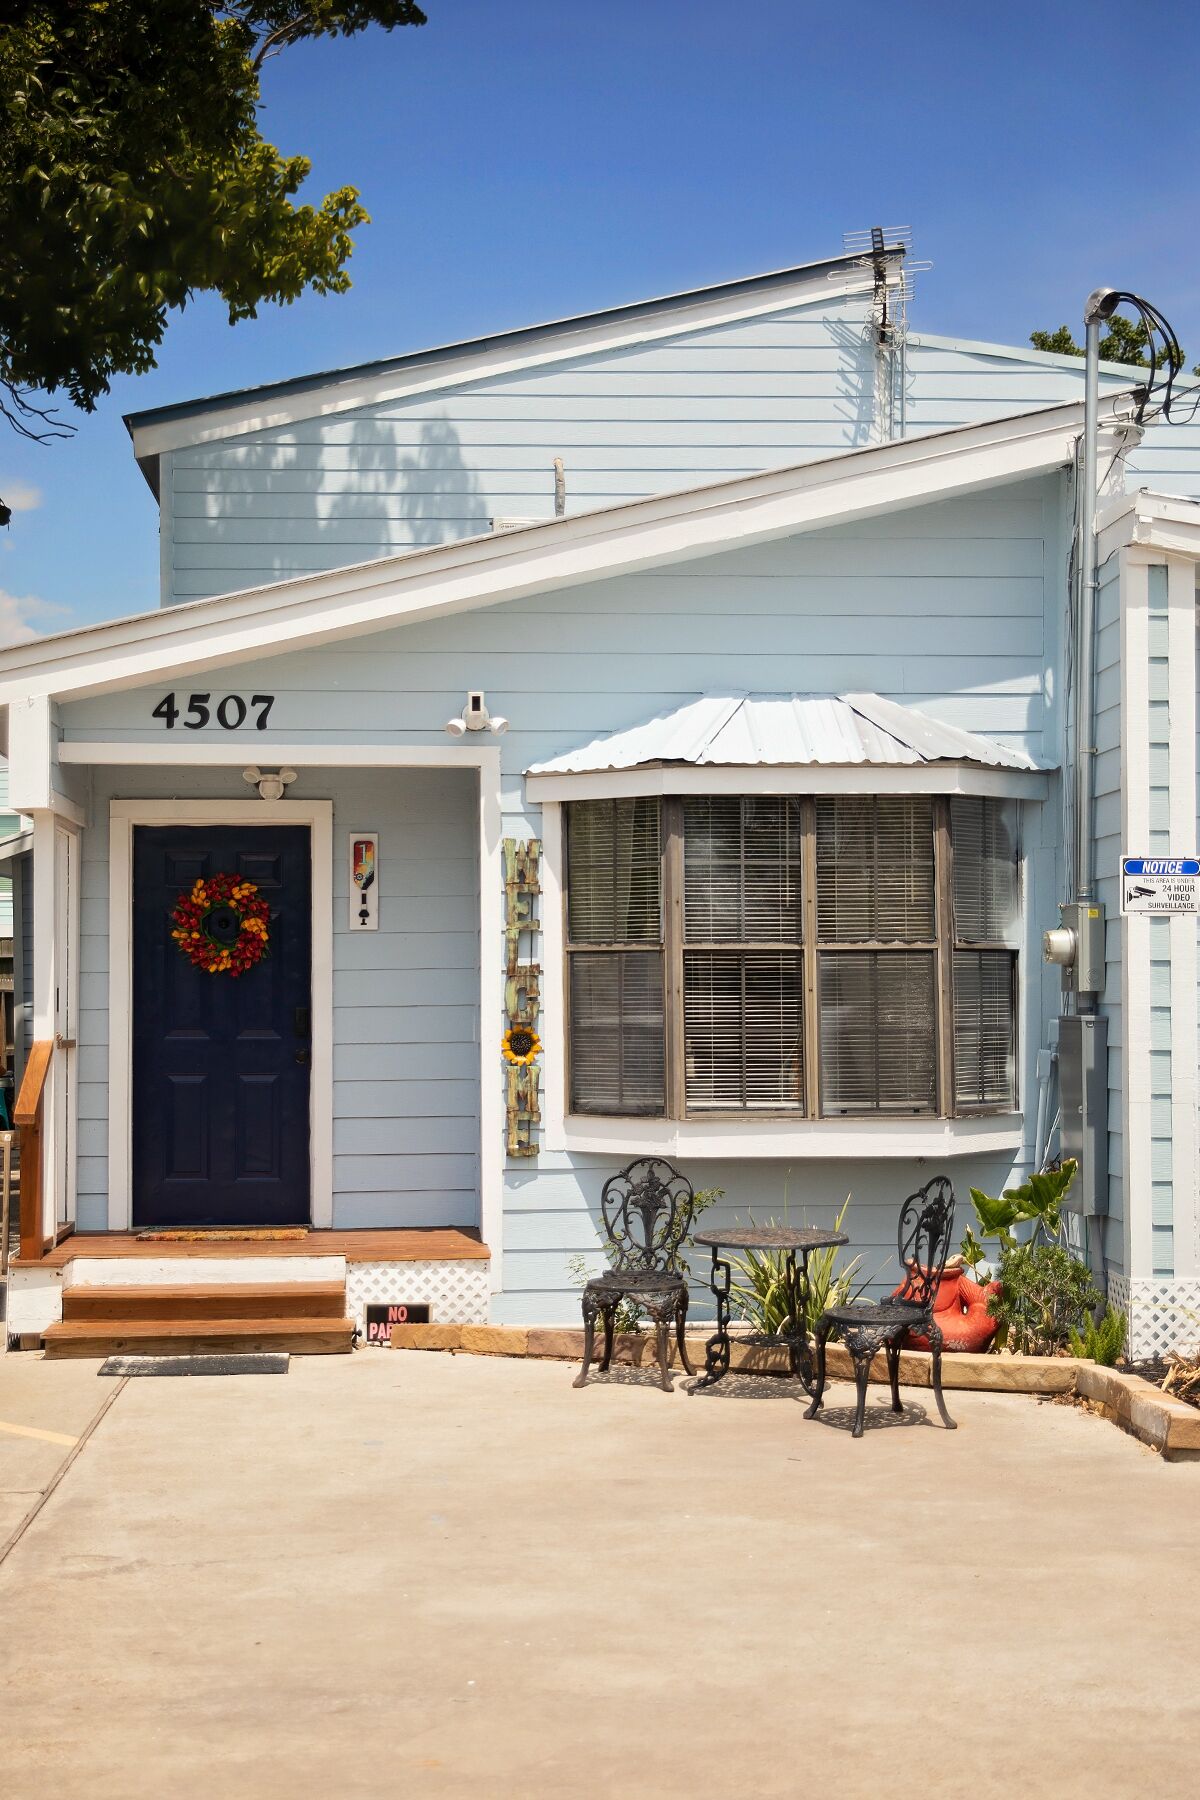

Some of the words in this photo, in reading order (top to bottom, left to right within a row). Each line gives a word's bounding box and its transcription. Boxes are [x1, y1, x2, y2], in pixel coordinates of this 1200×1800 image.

[152, 692, 275, 731] 4507
[359, 844, 368, 864] 1
[1142, 861, 1184, 874] NOTICE
[1162, 884, 1172, 892] 24
[1174, 884, 1195, 892] HOUR
[1167, 893, 1191, 901] VIDEO
[388, 1306, 408, 1321] NO
